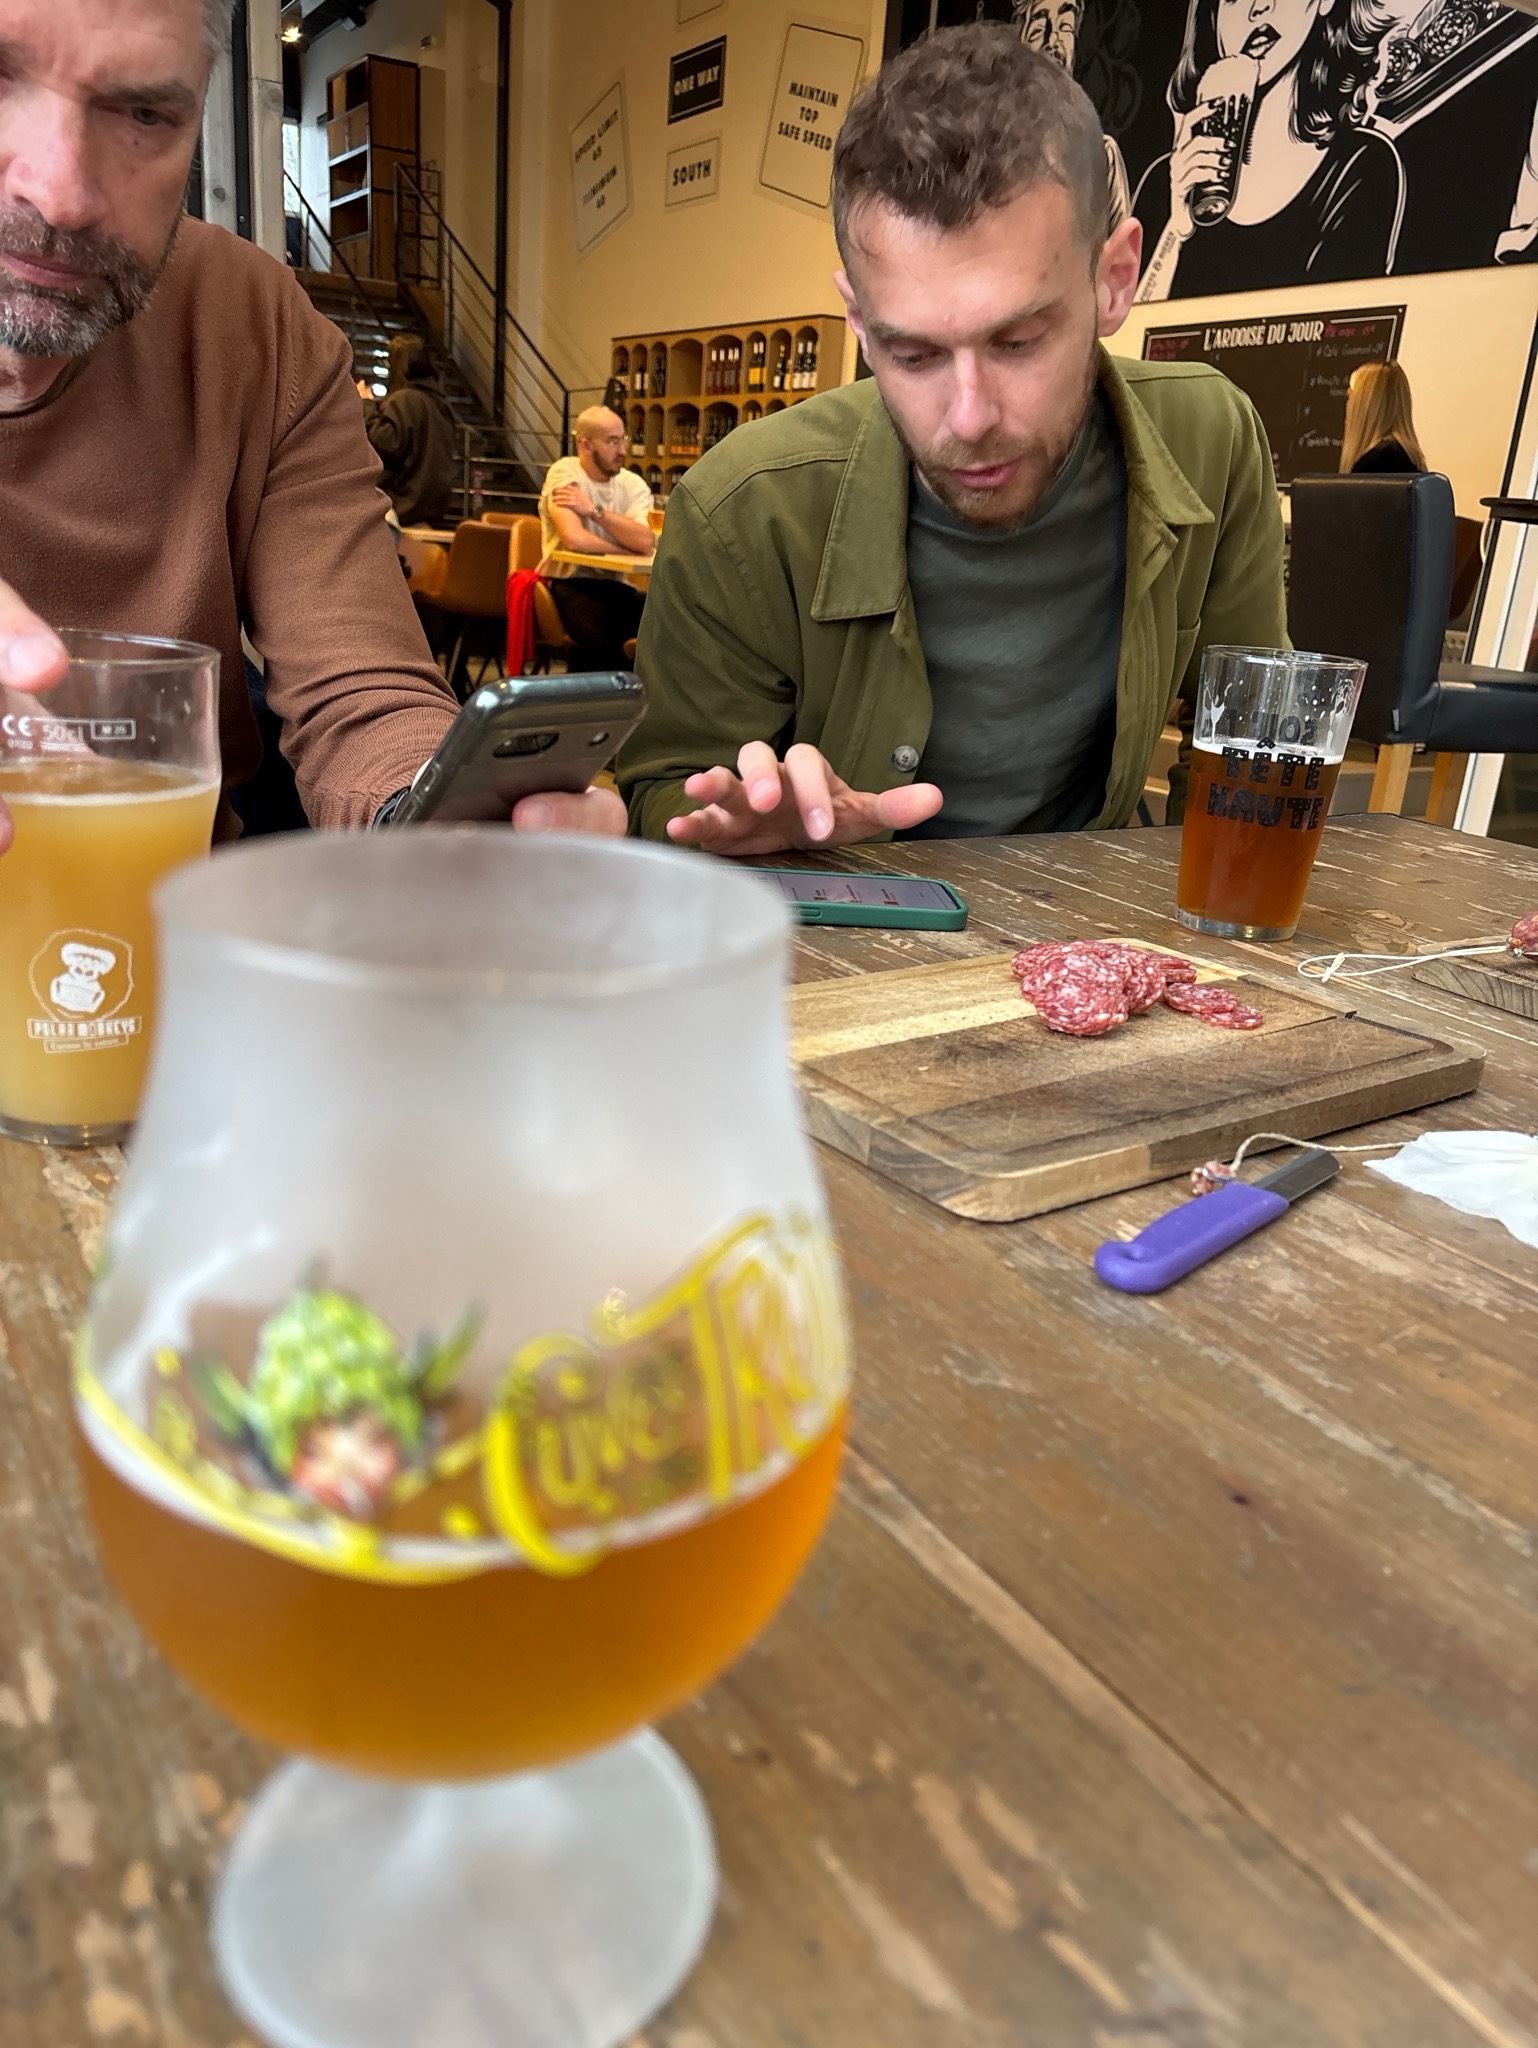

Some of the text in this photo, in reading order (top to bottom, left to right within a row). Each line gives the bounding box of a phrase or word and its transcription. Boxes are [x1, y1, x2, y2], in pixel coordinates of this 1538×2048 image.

[674, 65, 720, 96] ONE WAY
[788, 81, 839, 108] MAINTAIN
[800, 106, 818, 124] TOP
[778, 121, 832, 151] SAFE SPEED
[672, 158, 712, 187] SOUTH
[1203, 325, 1266, 352] L'ARDOISE
[1266, 323, 1287, 345] DU
[1287, 320, 1325, 343] JOUR
[1208, 783, 1325, 830] HAUTE
